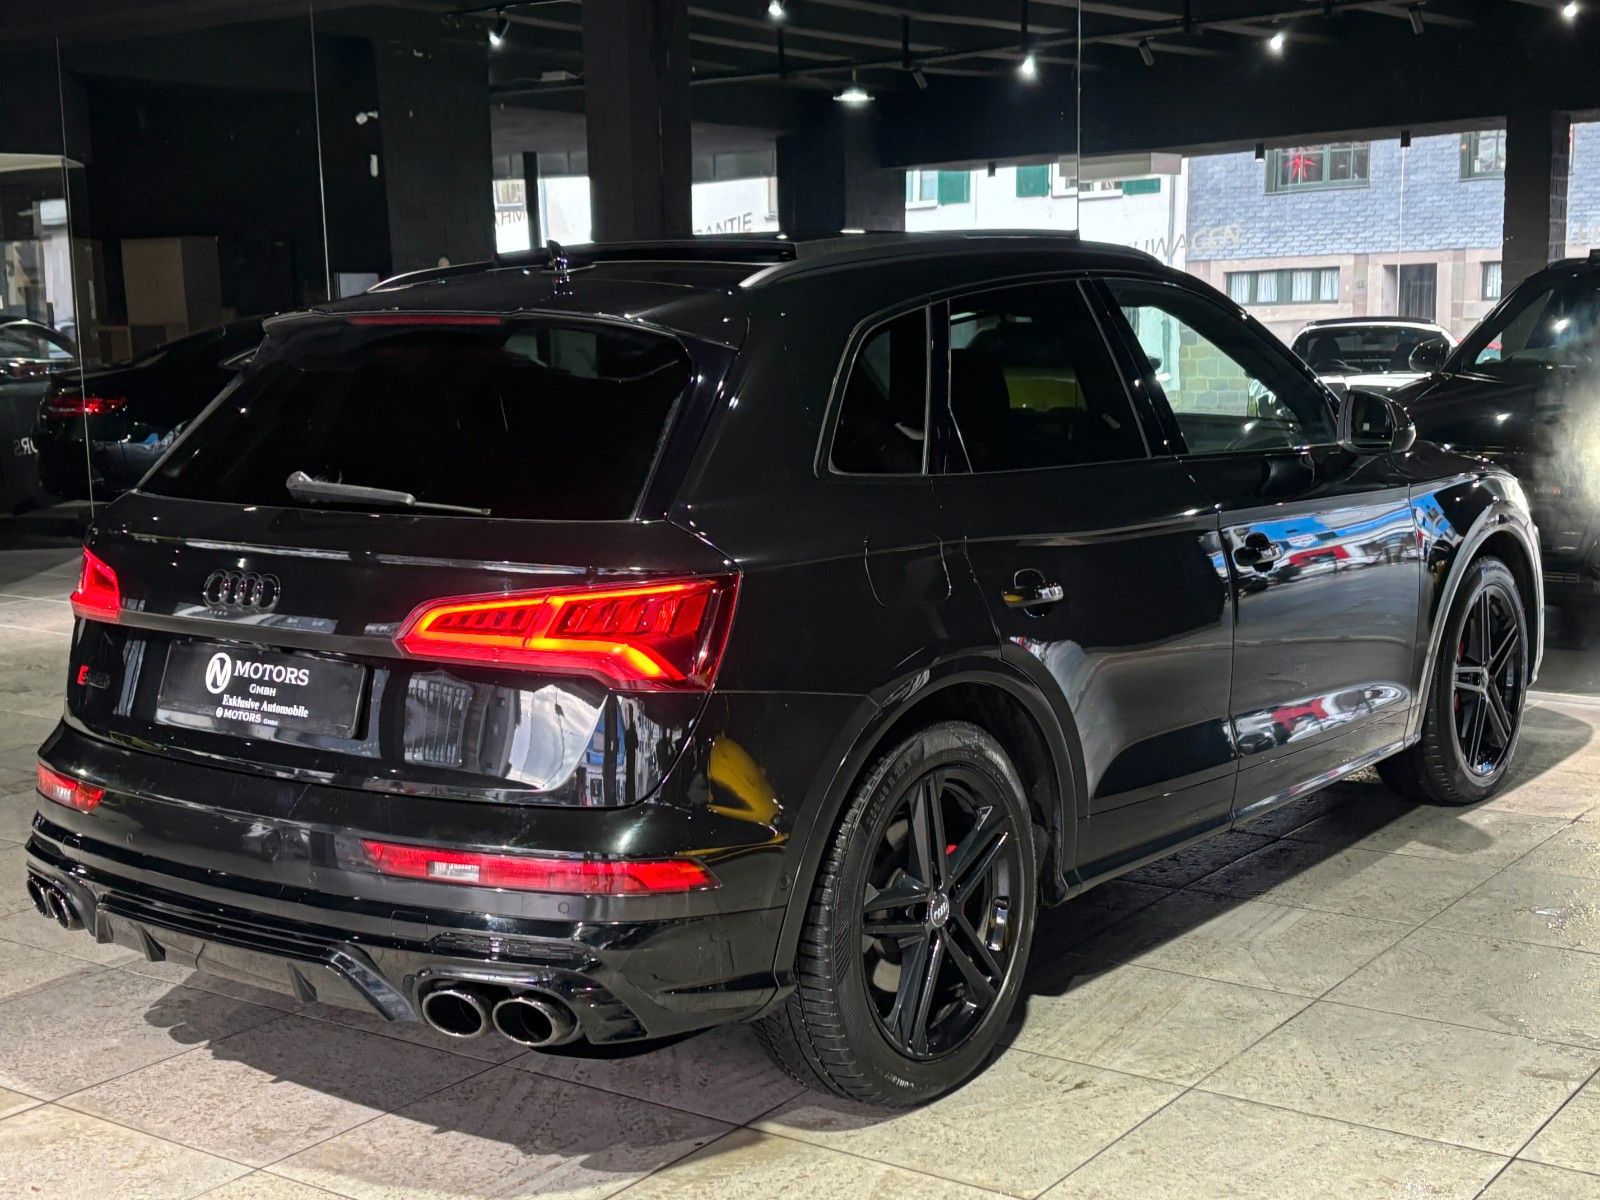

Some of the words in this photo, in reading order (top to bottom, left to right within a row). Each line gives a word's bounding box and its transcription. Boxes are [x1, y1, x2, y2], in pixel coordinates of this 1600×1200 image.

[234, 660, 310, 686] MOTORS
[249, 683, 277, 697] GMBH
[222, 694, 260, 709] Exklusive
[260, 700, 308, 717] Automobile
[223, 708, 261, 722] MOTORS
